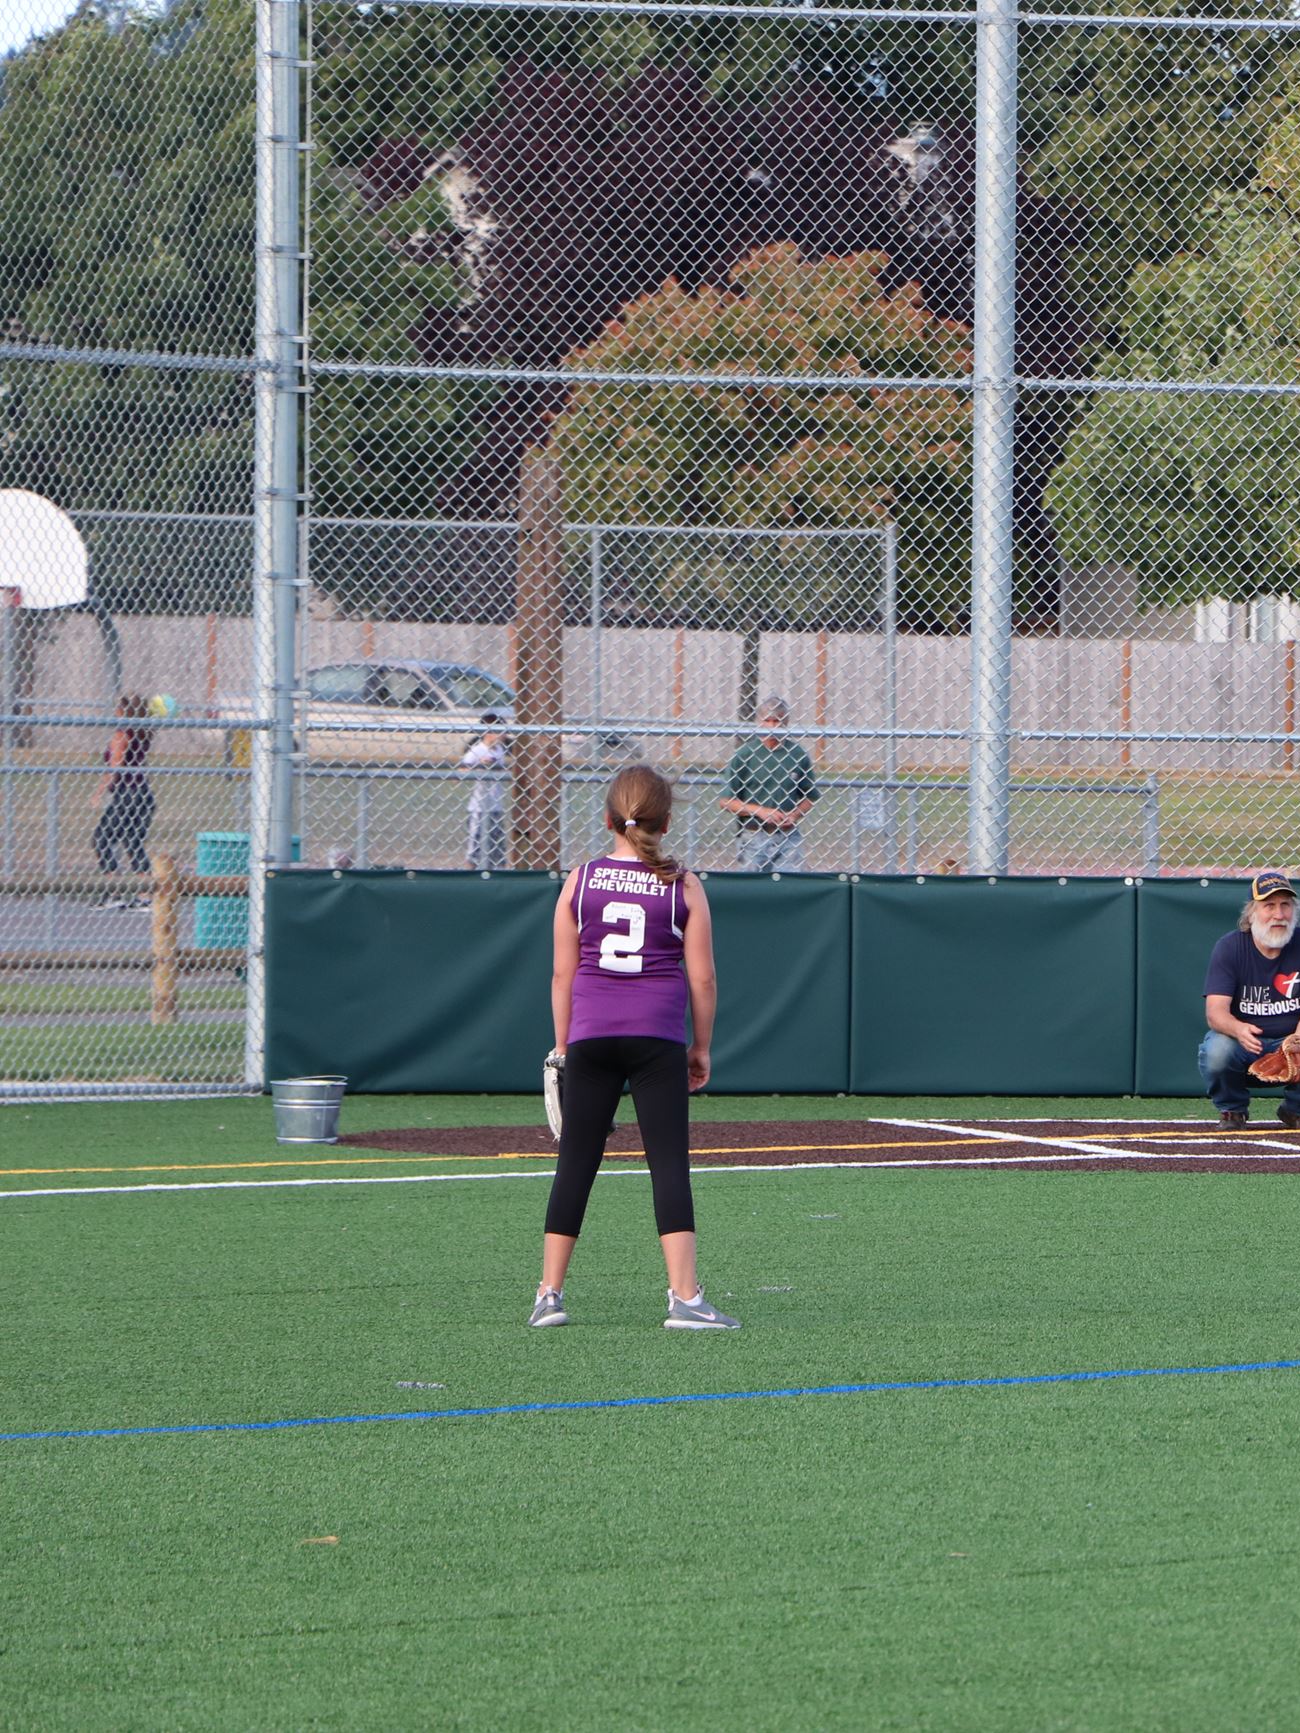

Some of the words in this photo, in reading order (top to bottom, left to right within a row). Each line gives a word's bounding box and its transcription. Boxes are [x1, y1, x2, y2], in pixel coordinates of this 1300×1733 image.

[593, 867, 664, 885] SPEEDWA
[588, 878, 668, 897] CHEVROLET
[599, 901, 646, 973] 2
[1240, 985, 1271, 1004] LIVE
